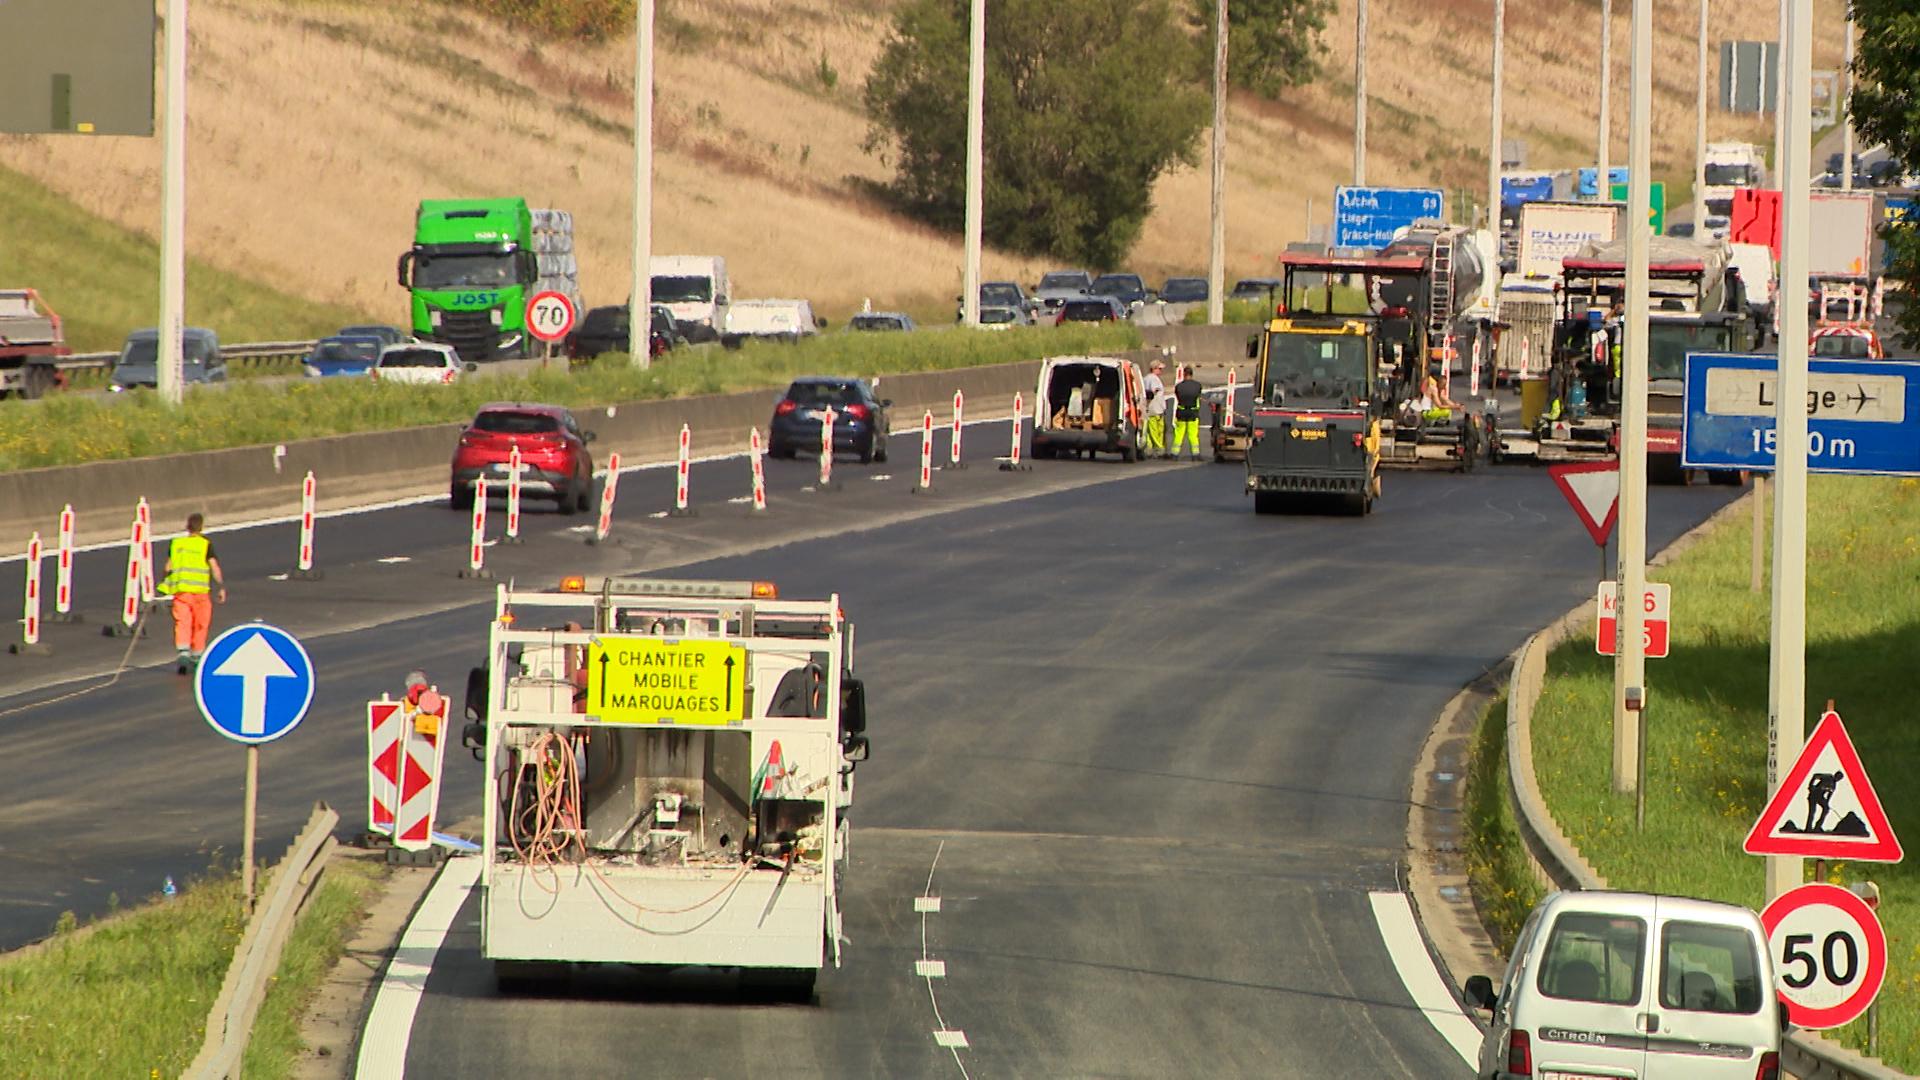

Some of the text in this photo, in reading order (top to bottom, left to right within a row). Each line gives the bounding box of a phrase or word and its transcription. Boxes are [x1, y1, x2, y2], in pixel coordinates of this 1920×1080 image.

[452, 292, 499, 306] JOST
[536, 305, 563, 326] 70
[1759, 382, 1836, 414] Lge
[1752, 429, 1856, 458] 150 m
[618, 651, 706, 668] CHANTIER
[633, 673, 698, 690] MOBILE
[611, 694, 720, 712] MARQUAGES
[1782, 930, 1858, 989] 50
[1547, 1029, 1606, 1044] CITROËN
